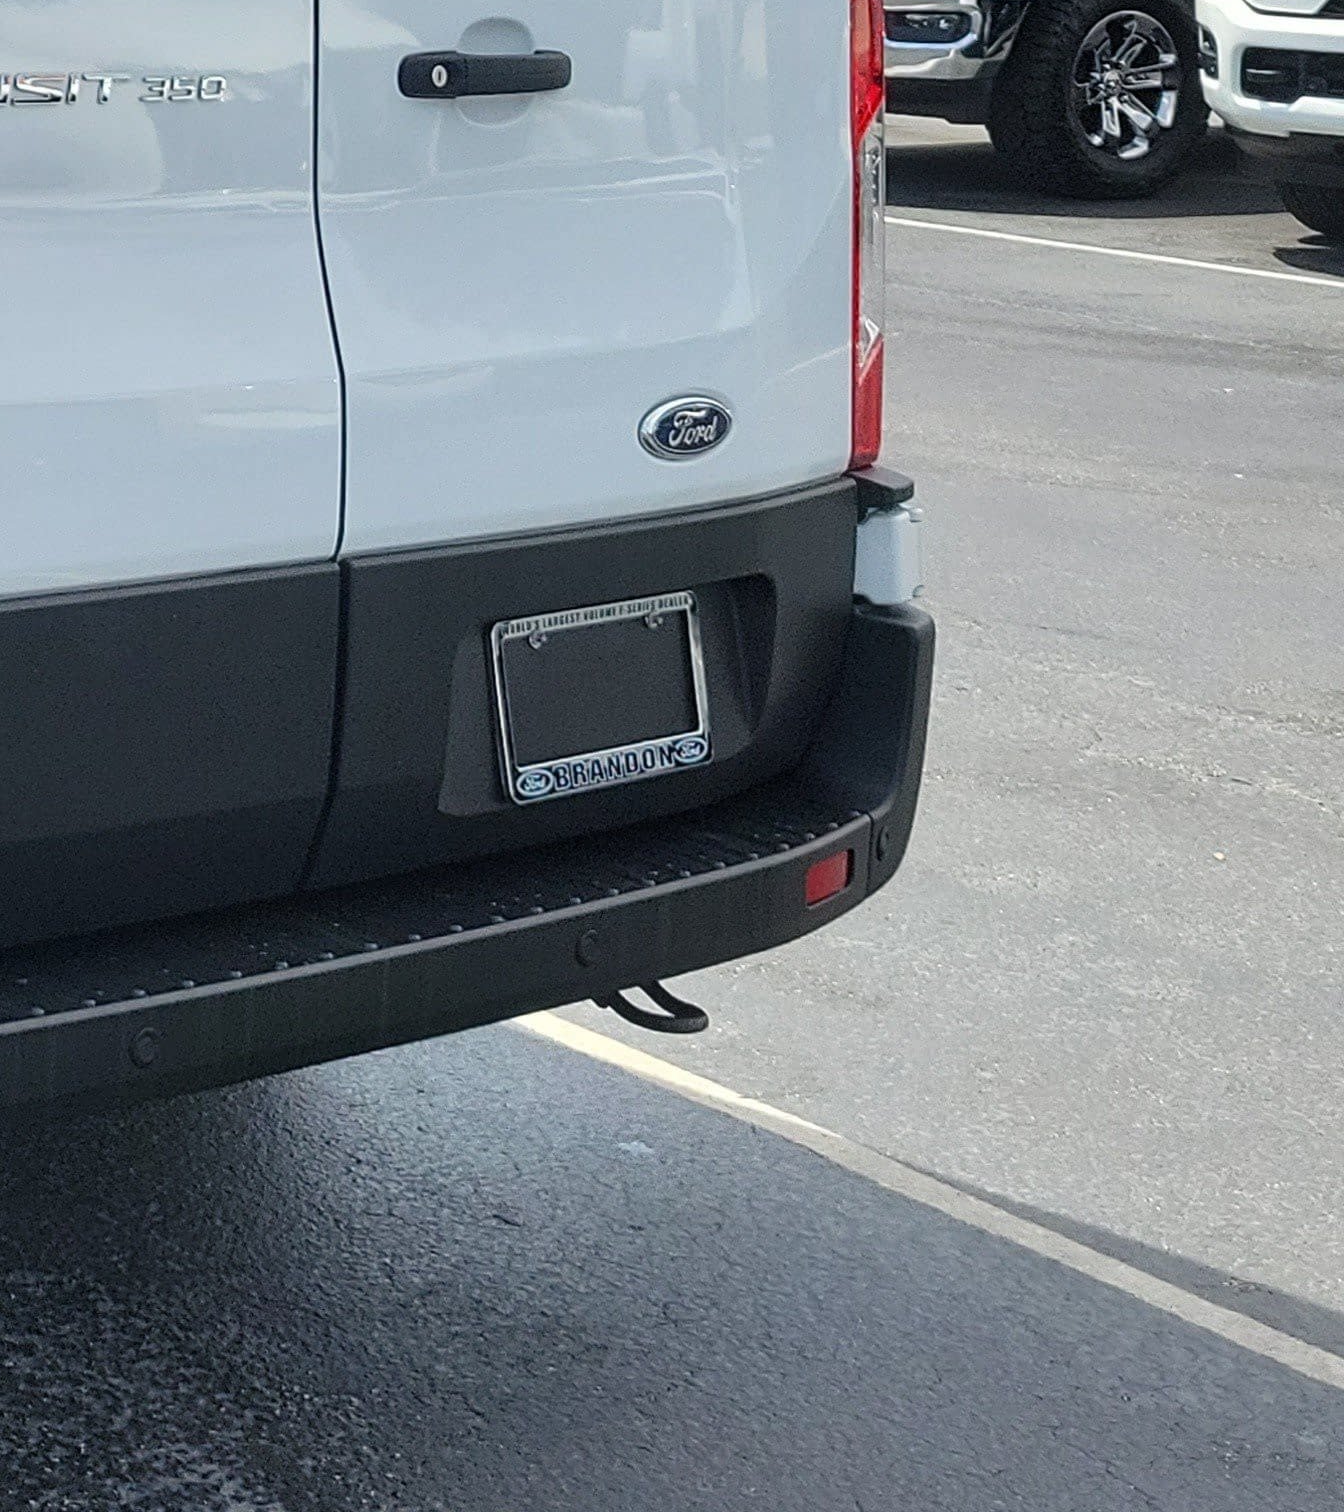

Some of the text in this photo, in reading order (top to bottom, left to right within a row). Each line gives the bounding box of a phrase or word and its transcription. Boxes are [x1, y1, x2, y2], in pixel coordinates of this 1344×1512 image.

[138, 75, 229, 103] 350
[668, 409, 718, 447] Ford
[554, 744, 675, 789] BRANDON
